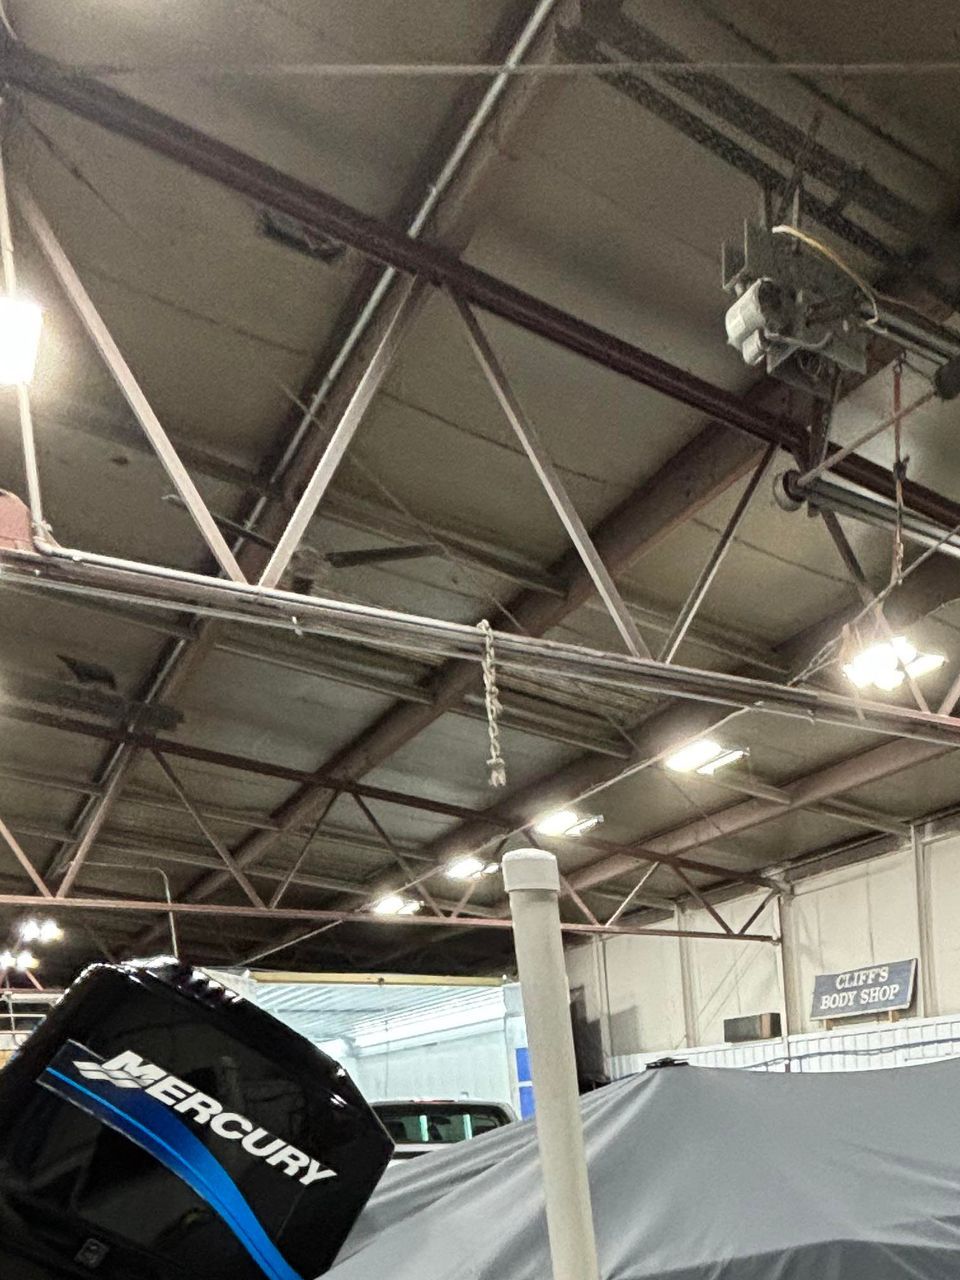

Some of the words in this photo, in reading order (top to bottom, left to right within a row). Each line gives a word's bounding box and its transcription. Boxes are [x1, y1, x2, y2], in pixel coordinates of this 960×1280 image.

[835, 966, 889, 990] CLIFF'S
[819, 990, 858, 1010] BODY
[860, 983, 900, 1005] SHOP
[73, 1050, 338, 1186] MERCURY
